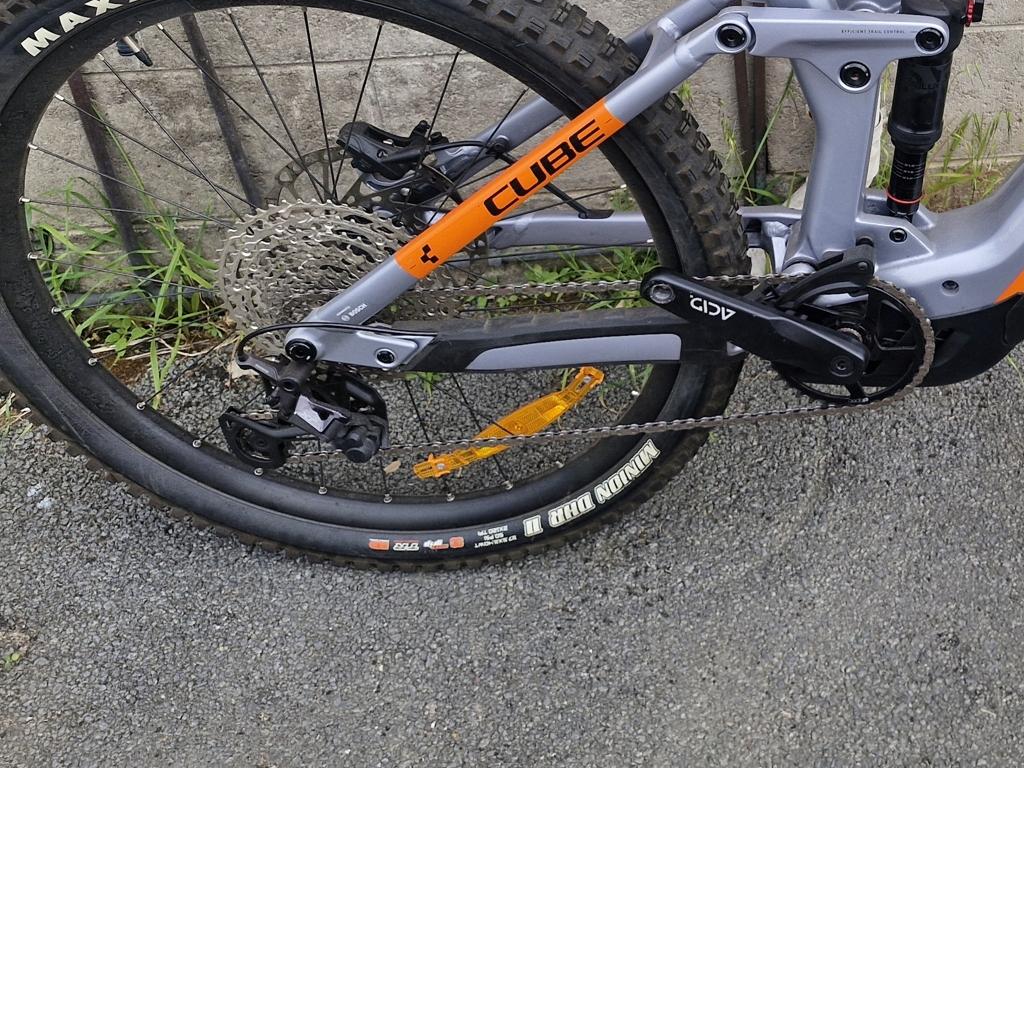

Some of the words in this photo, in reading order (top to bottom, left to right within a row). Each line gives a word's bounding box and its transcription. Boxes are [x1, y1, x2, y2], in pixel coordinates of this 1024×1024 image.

[483, 119, 606, 217] CUBE
[594, 438, 661, 504] MINION
[548, 491, 596, 528] DHR
